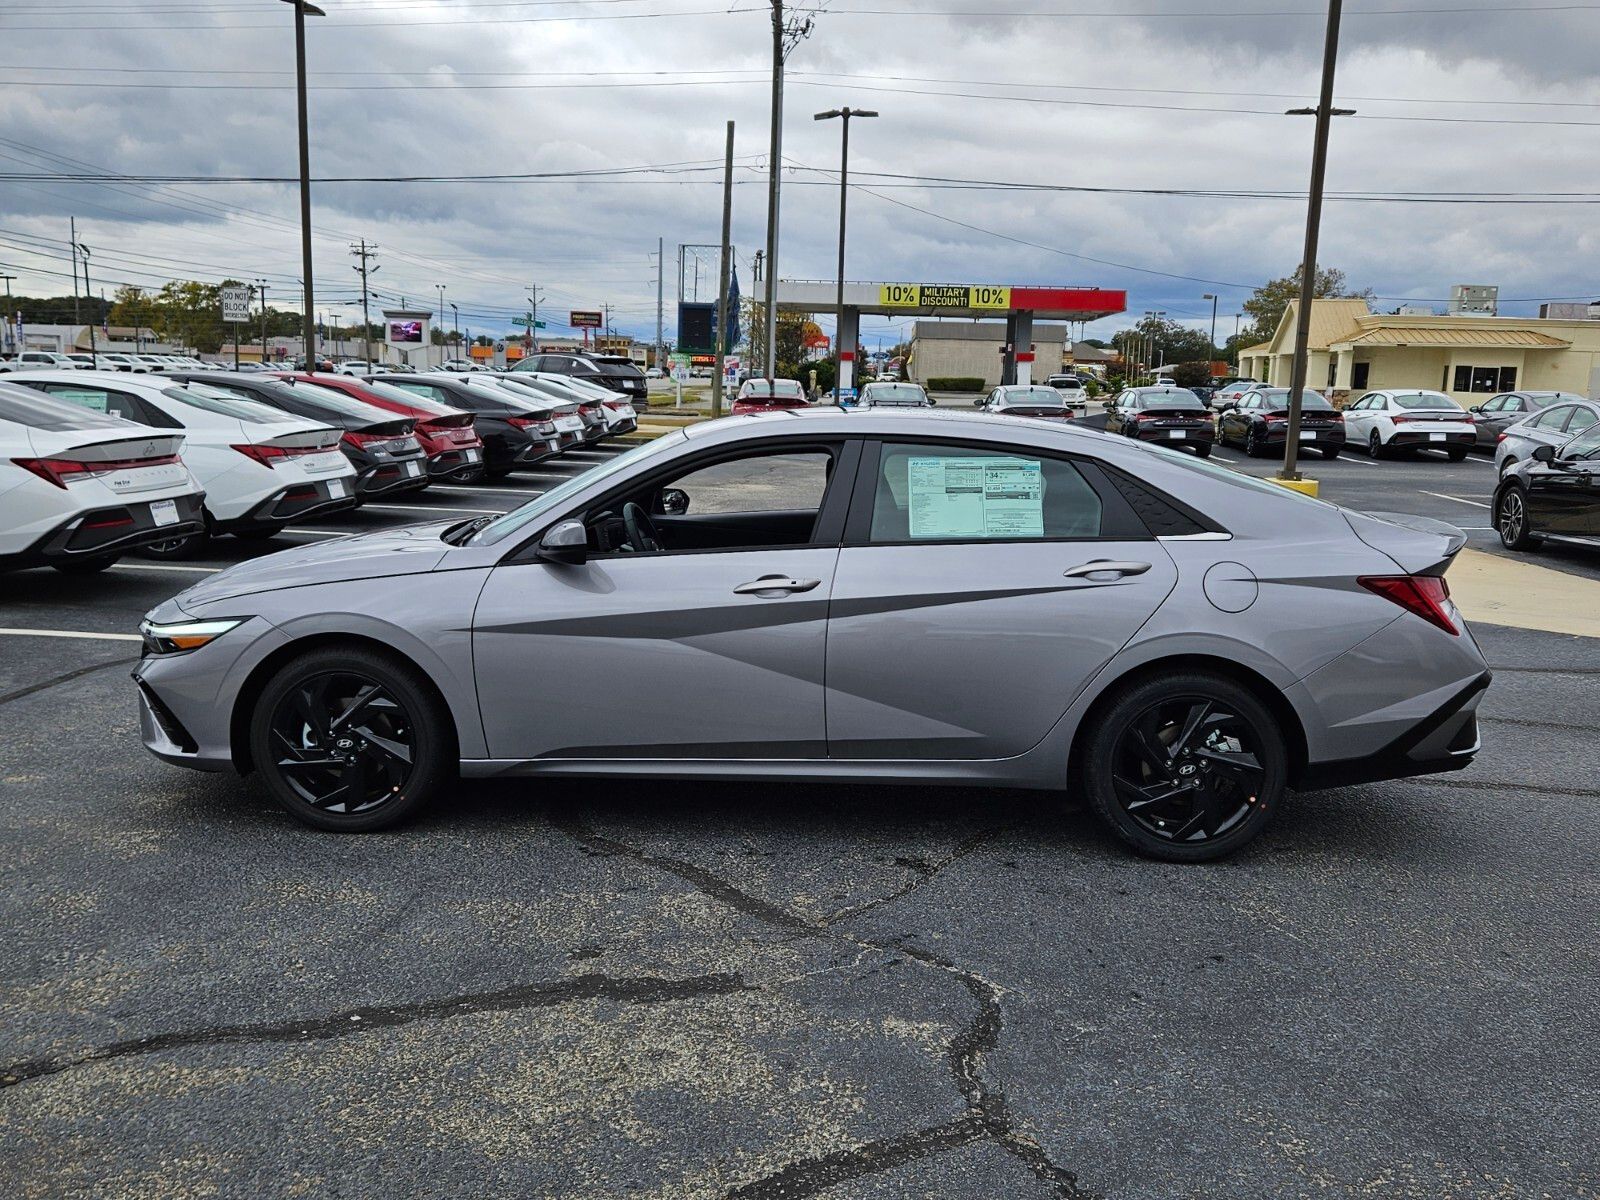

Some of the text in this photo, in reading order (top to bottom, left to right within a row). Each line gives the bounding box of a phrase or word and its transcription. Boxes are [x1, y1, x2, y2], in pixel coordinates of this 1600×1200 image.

[224, 291, 247, 300] DO NOT
[886, 286, 915, 302] 10%
[924, 287, 965, 297] MILITARY
[975, 288, 1003, 304] 10%
[921, 297, 967, 306] DISCOUNT!
[224, 302, 247, 311] BLOCK
